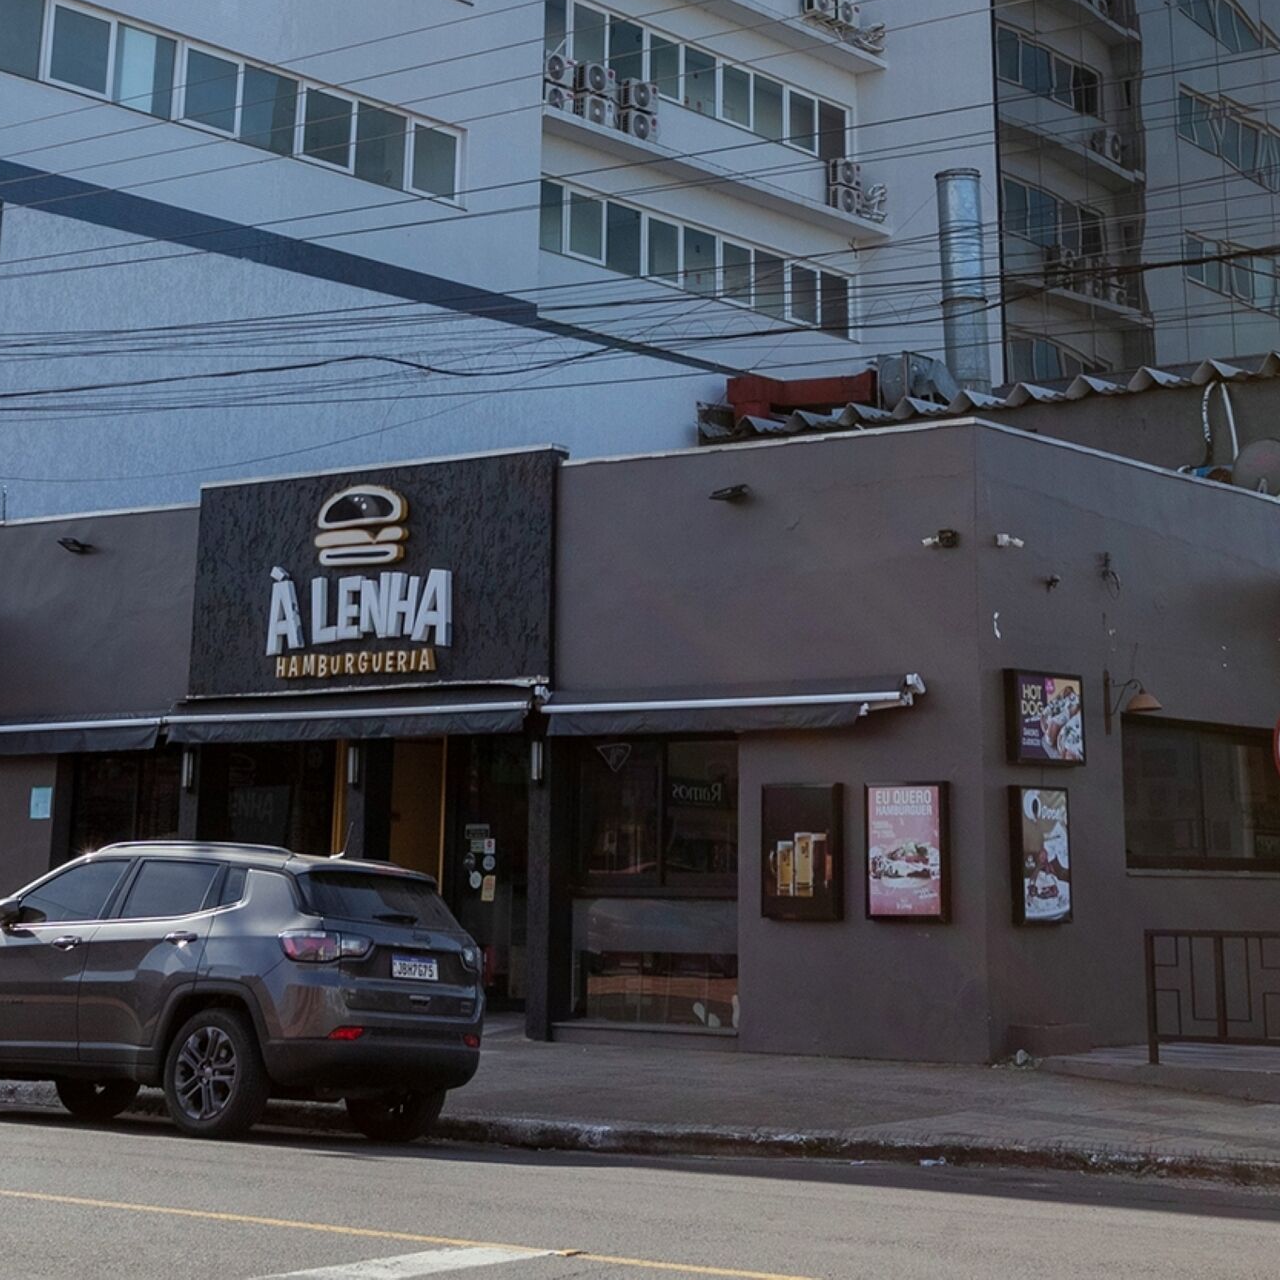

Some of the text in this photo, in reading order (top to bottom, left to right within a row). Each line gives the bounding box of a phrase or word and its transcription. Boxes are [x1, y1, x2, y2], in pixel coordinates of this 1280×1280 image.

[266, 566, 452, 656] À LENHA
[275, 648, 436, 678] HAMBURGUERIA
[1022, 684, 1042, 700] HOT
[1021, 700, 1043, 716] DOG
[875, 789, 932, 805] EU QUERO
[875, 805, 933, 816] HAMBURGUER
